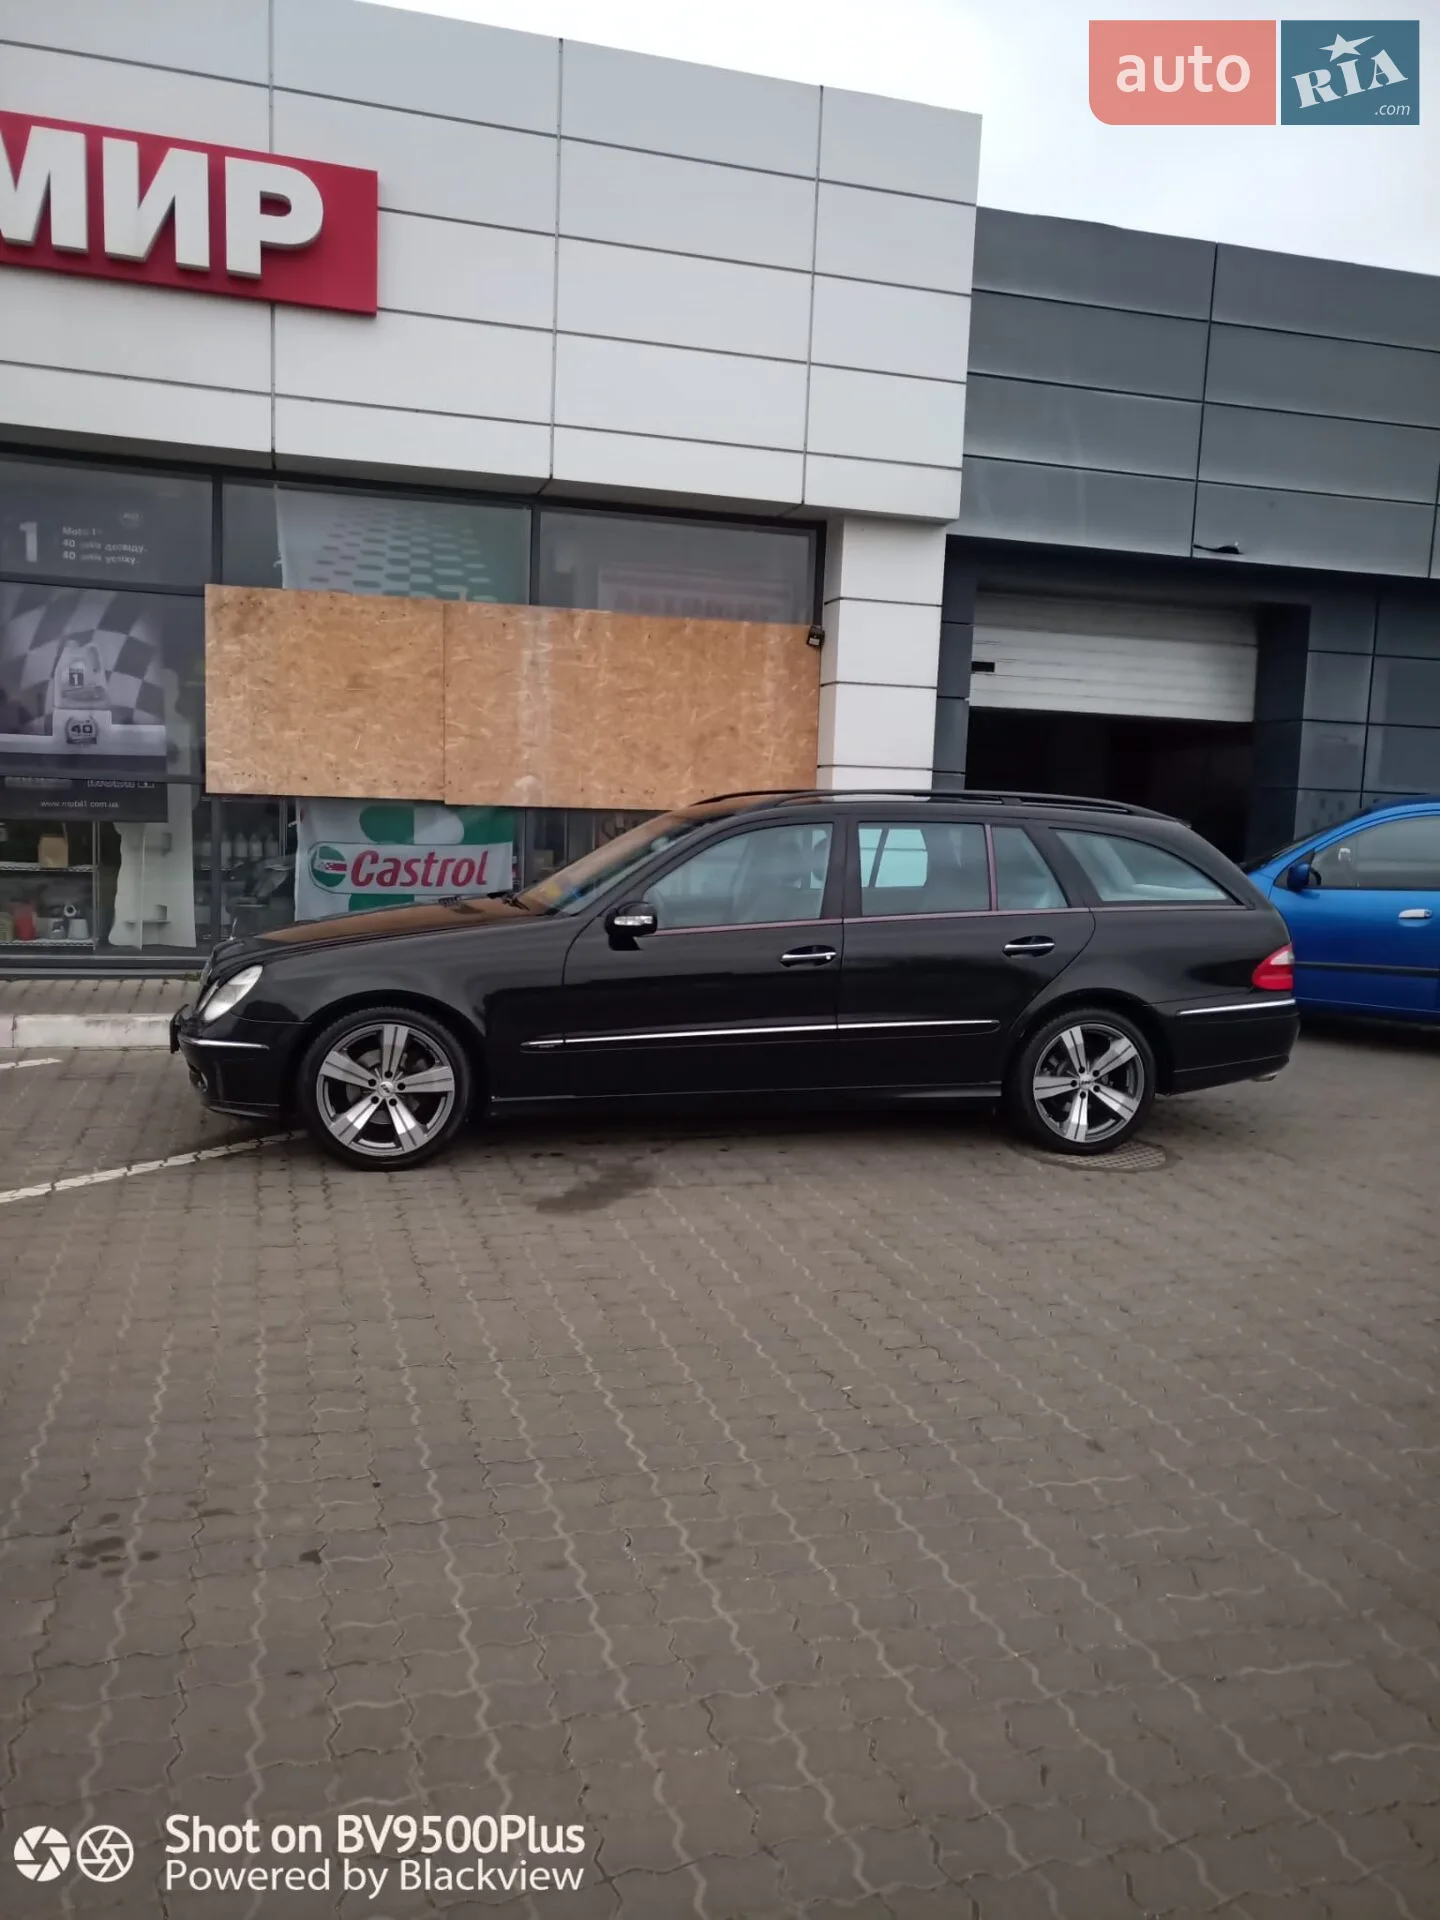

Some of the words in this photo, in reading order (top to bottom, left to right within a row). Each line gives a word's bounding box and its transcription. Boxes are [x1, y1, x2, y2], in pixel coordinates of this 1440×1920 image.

[20, 521, 38, 562] 1
[71, 724, 93, 735] 40
[351, 850, 489, 888] Castrol
